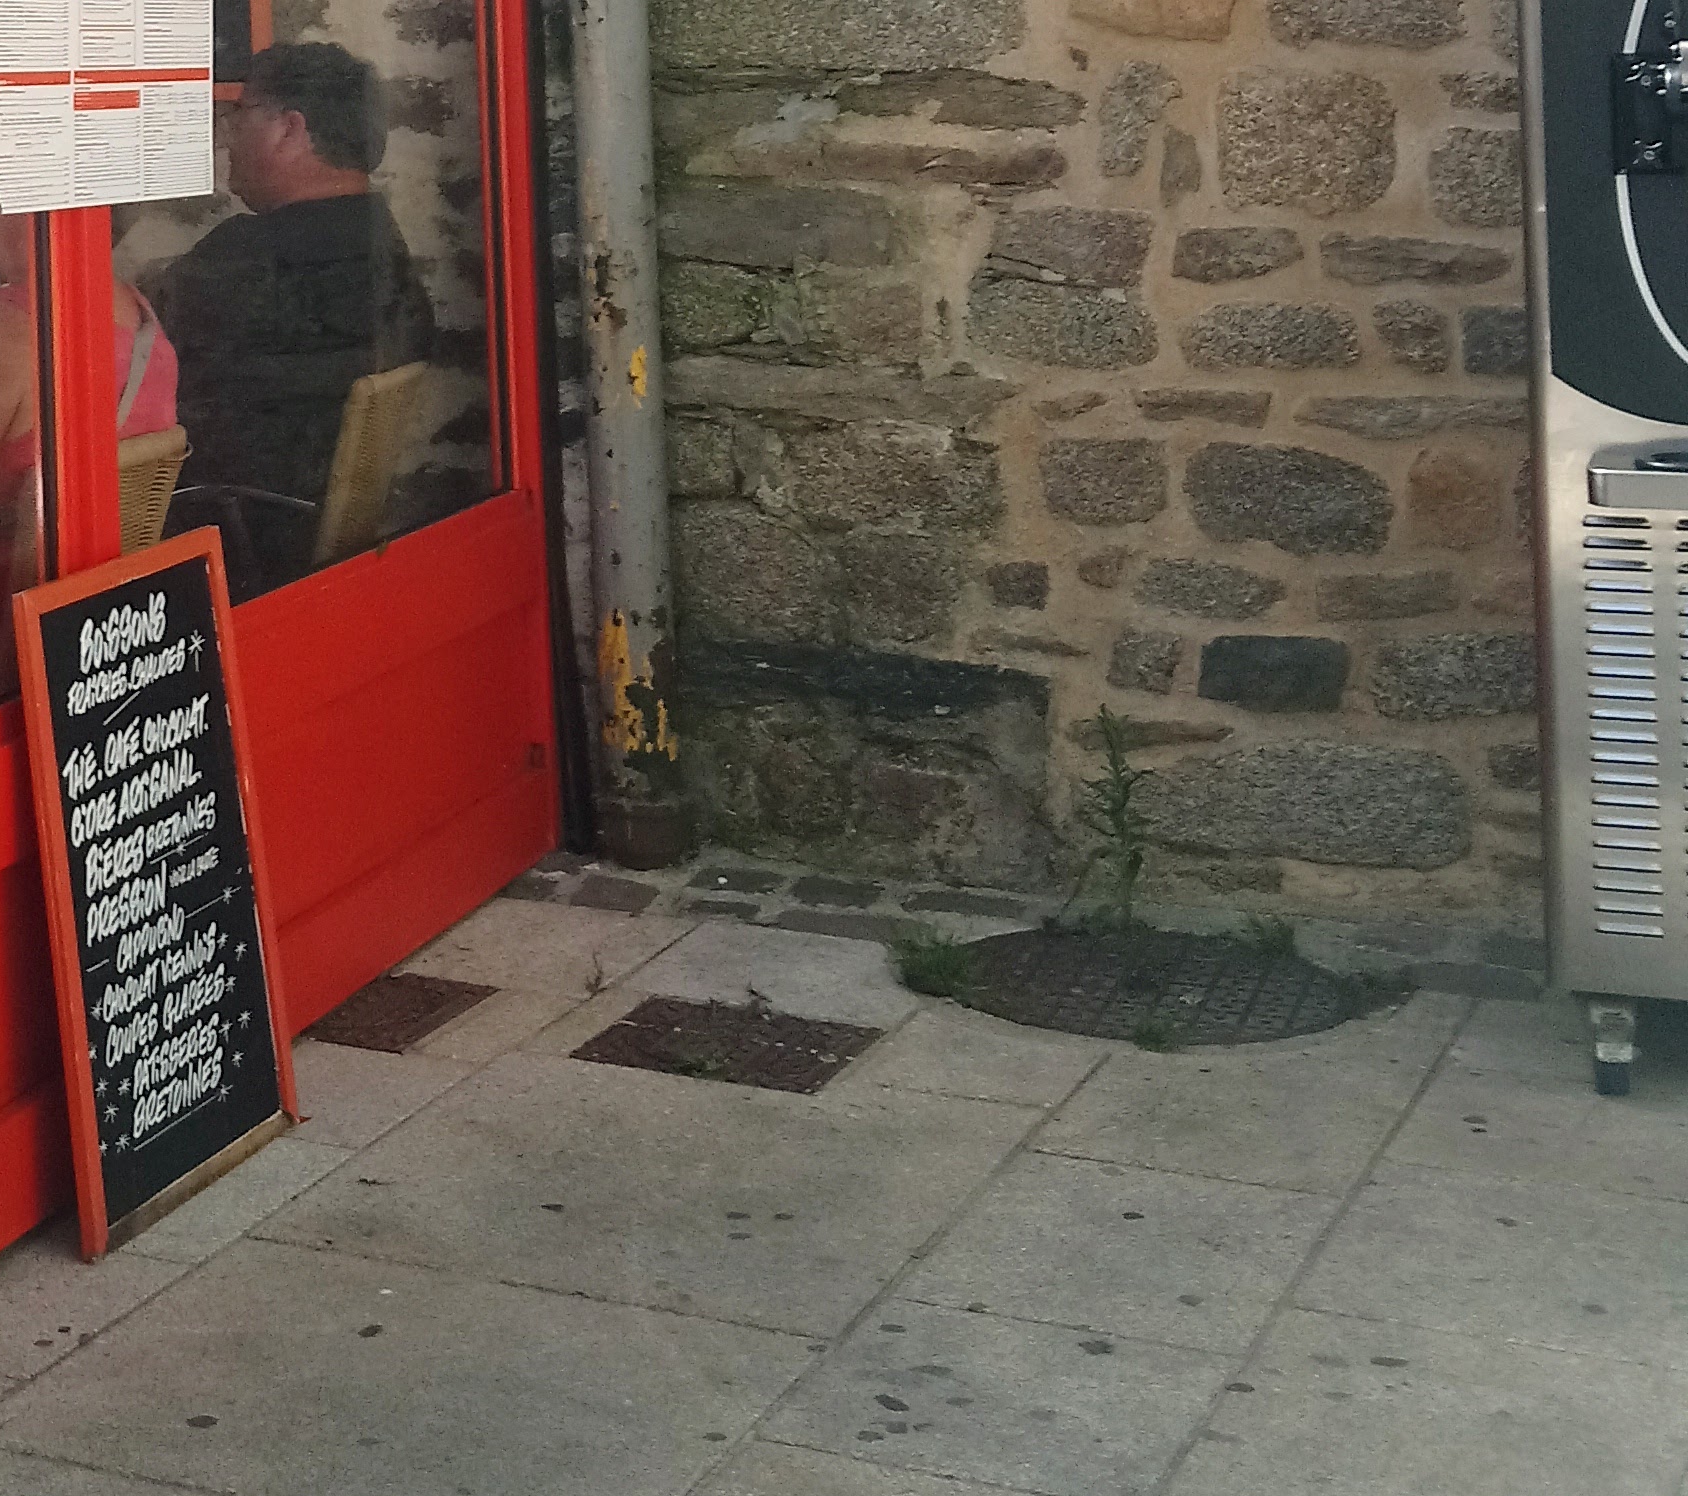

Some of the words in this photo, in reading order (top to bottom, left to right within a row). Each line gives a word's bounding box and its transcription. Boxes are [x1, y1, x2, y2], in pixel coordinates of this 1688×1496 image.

[79, 591, 167, 675] BOISSONS
[70, 788, 117, 848] CIDRE
[145, 791, 217, 859] BRETONNES
[86, 859, 167, 948] PRESSION
[102, 957, 160, 1023] CHOCOLAT
[160, 921, 217, 987] VIENNOIS
[105, 1001, 159, 1068] COUPES
[162, 962, 225, 1035] GLACÉES
[132, 1046, 224, 1139] BRETONNES
